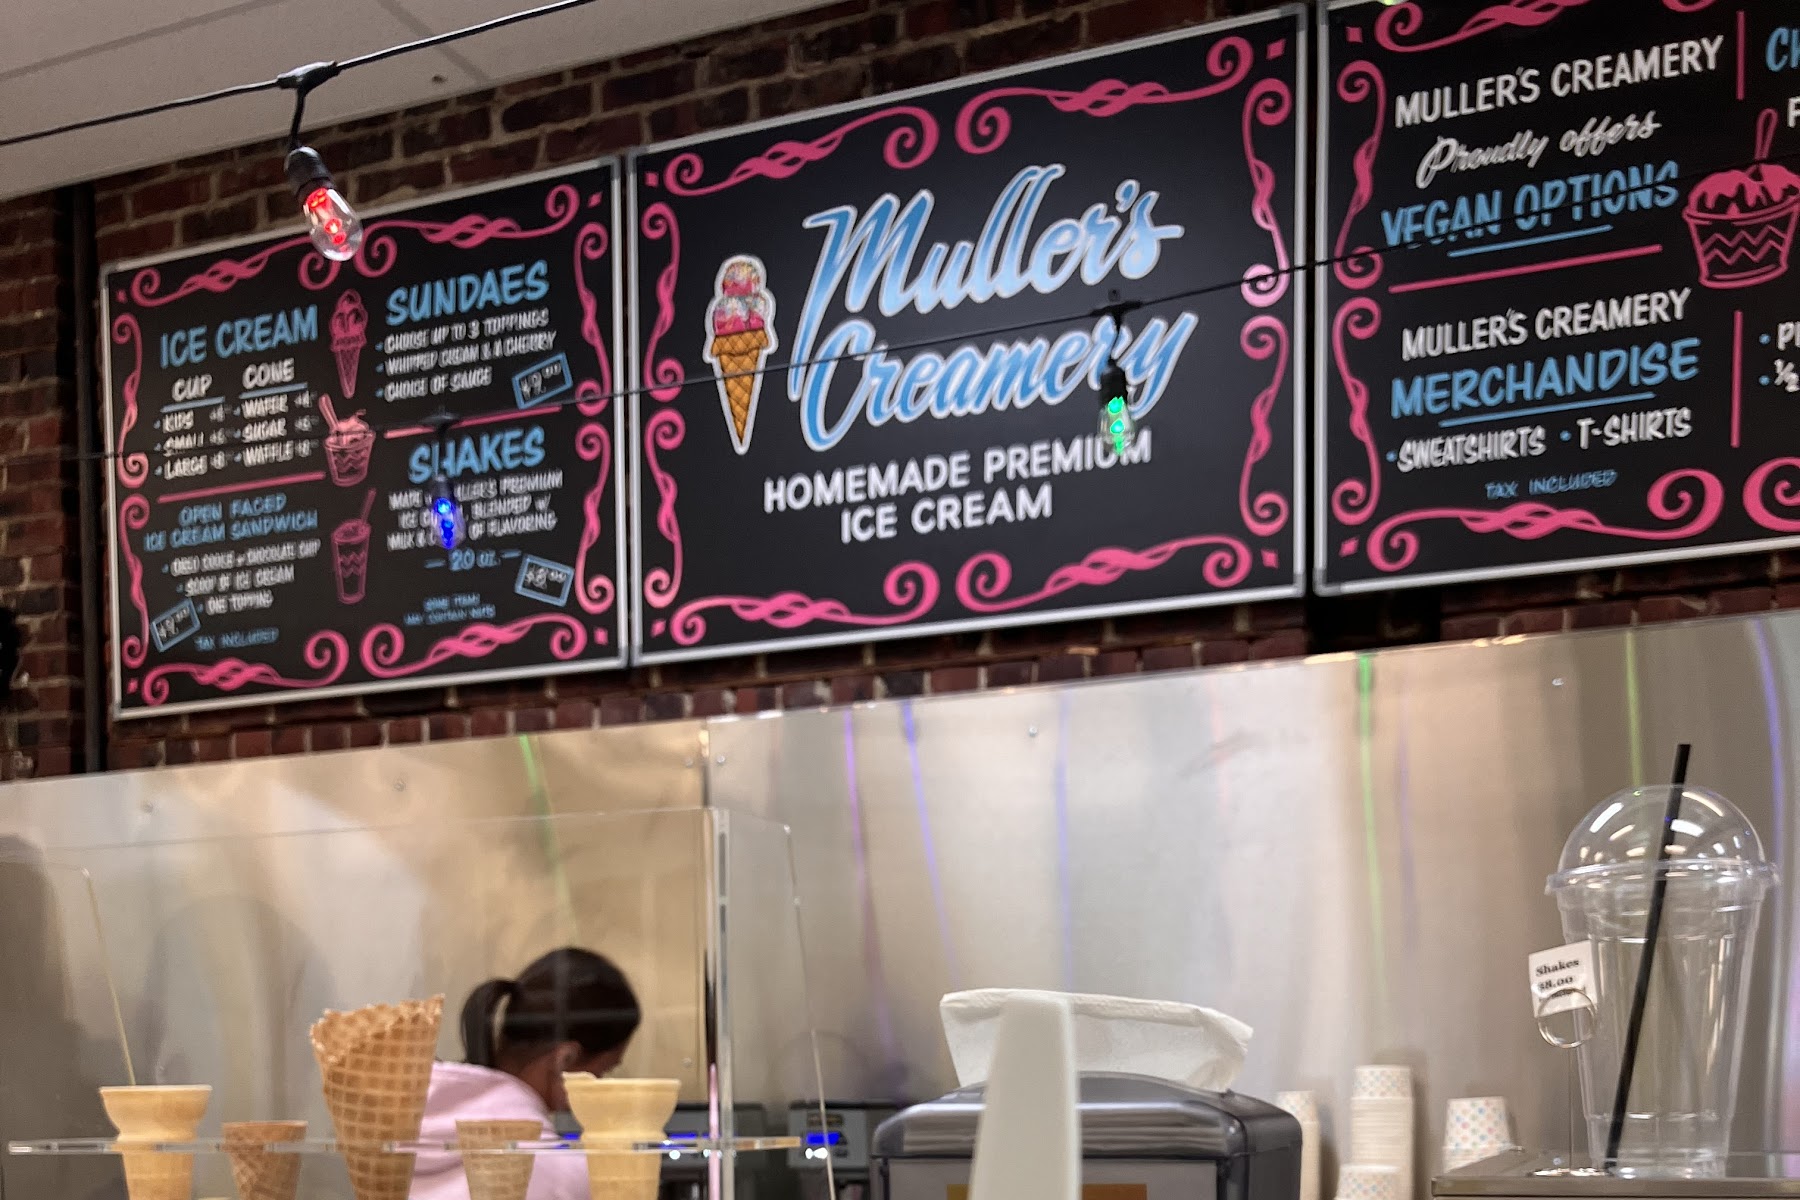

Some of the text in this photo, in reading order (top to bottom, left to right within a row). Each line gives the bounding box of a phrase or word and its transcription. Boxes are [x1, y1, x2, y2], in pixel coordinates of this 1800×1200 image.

[1395, 34, 1725, 128] MULLER'S CREAMERY
[1415, 109, 1662, 190] Proudly offers
[1381, 159, 1679, 250] VEGAN OPTIONS
[386, 259, 550, 326] SUNDAES
[787, 163, 1185, 401] Muller's
[160, 304, 318, 369] ICE CREAM
[384, 329, 430, 354] CHOOSE
[430, 325, 450, 346] UP
[451, 322, 467, 341] TO
[482, 307, 549, 337] TOPPINGS
[1402, 287, 1692, 362] MULLER'S CREAMERY
[242, 357, 295, 389] CONE
[384, 351, 438, 377] WHIPPED
[438, 343, 479, 368] CREAM
[503, 330, 557, 357] CHERRY
[172, 373, 213, 402] CUP
[384, 366, 493, 402] CHOICE OF SAUCE
[799, 312, 1199, 453] Creamery
[1391, 337, 1701, 419] MERCHANDISE
[162, 409, 195, 433] KIDS
[242, 417, 287, 443] SUGAR
[1396, 406, 1693, 473] SWEATSHIRTS T-SHIRTS
[163, 455, 208, 481] LARGE
[408, 425, 546, 484] SHAKES
[763, 427, 1152, 514] HOMEMADE PREMIUM
[500, 468, 563, 494] PREMIUM
[1485, 469, 1619, 500] TAX INCLUDED
[179, 493, 287, 526] OPEN FACED
[468, 520, 486, 540] OF
[486, 511, 558, 538] FLAVORING
[471, 494, 532, 520] BLENDED
[840, 483, 1053, 544] ICE CREAM
[143, 509, 318, 551] ICE CREAM SANDWICH
[253, 563, 295, 588] CREAM
[450, 549, 475, 572] 20
[1536, 960, 1580, 977] Shakes
